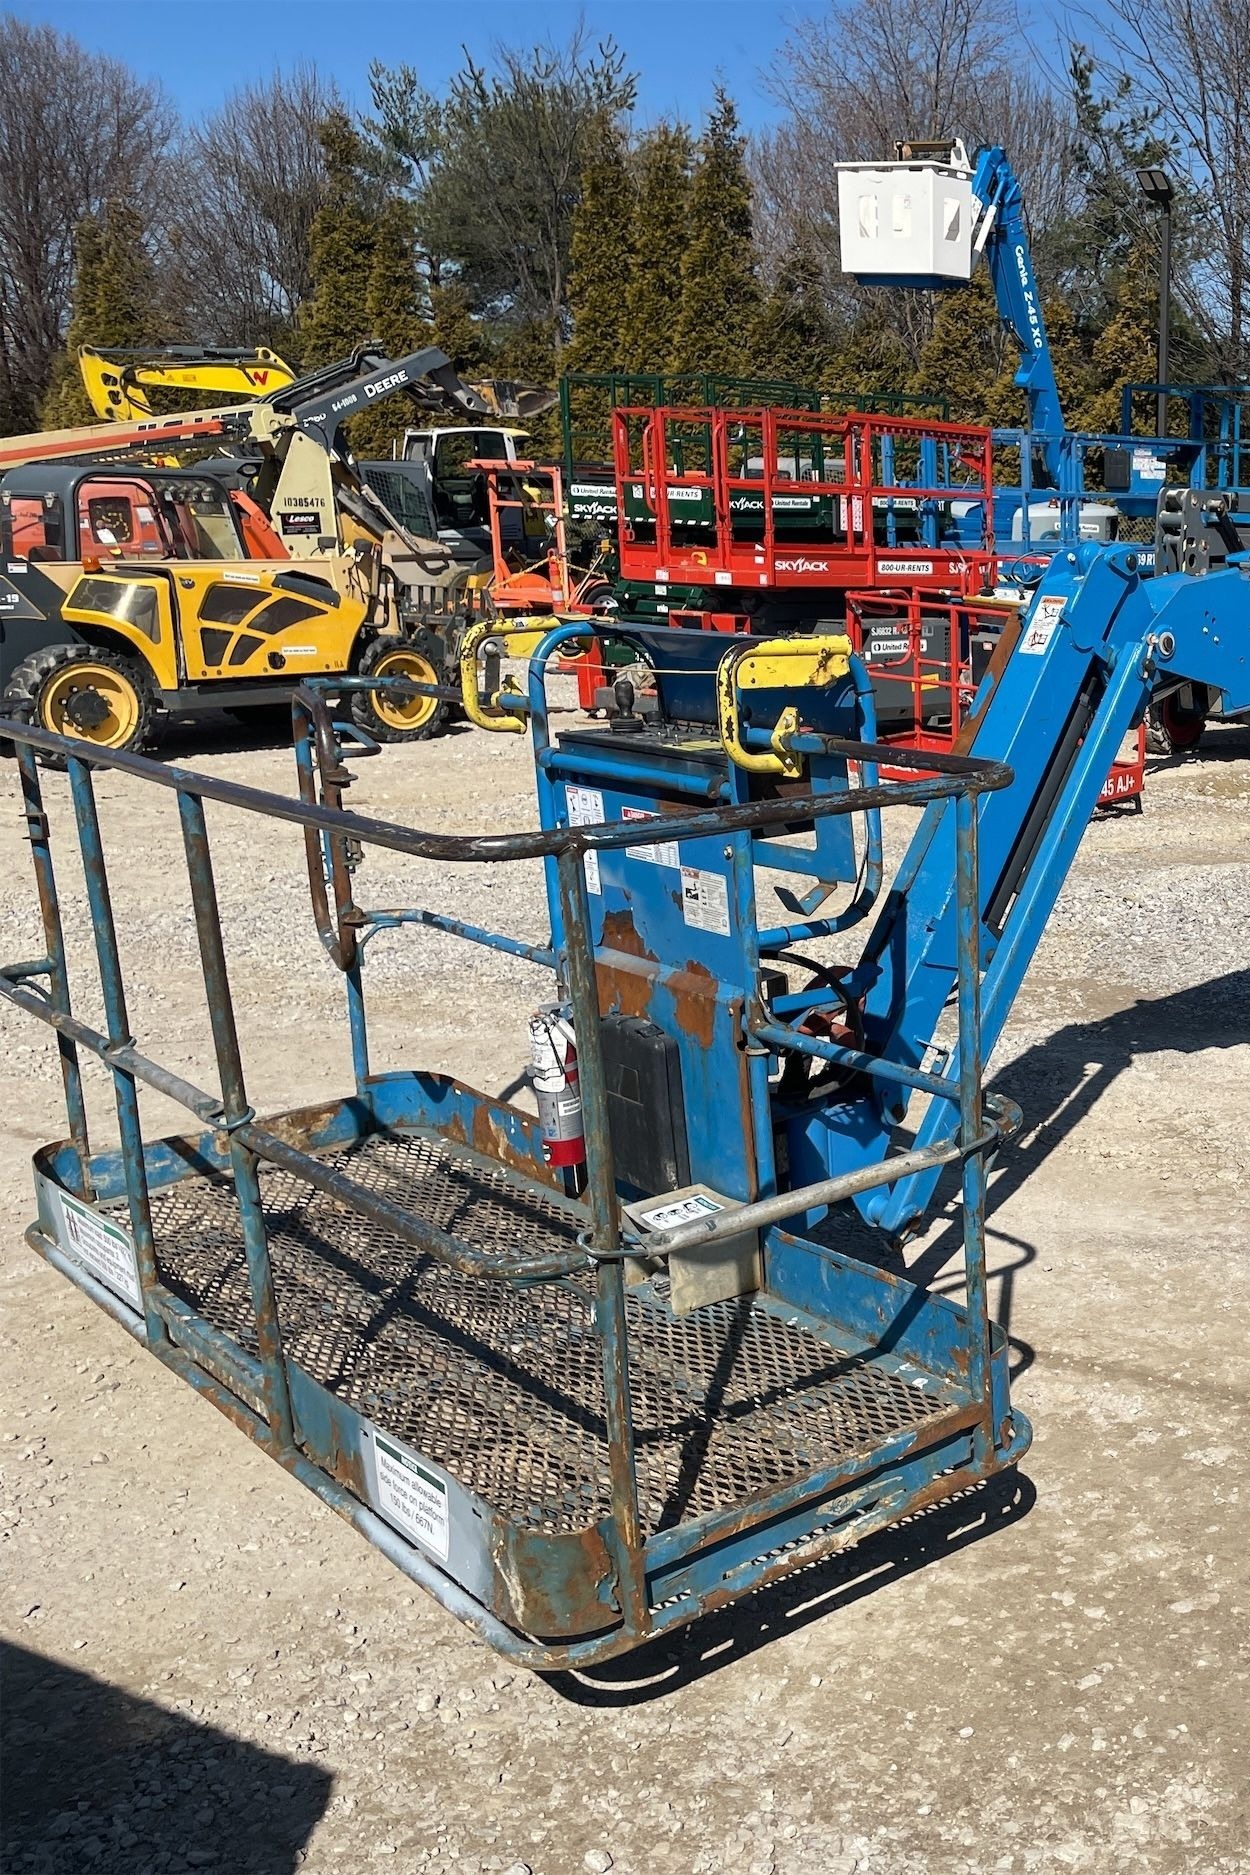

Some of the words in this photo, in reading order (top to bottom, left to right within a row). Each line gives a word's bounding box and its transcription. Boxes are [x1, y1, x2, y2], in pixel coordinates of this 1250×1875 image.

[1015, 245, 1029, 287] Genie
[1024, 291, 1038, 325] Z-45
[1031, 327, 1042, 348] XC
[363, 370, 409, 398] DEERE
[284, 497, 326, 507] 10385476
[574, 501, 617, 514] SKYJACK
[730, 497, 764, 510] KYJACK
[289, 514, 315, 523] Lesco
[775, 557, 829, 573] SKYJACK
[881, 564, 930, 573] 800-UR-RENTS
[882, 642, 902, 651] United
[381, 1456, 411, 1486] Maximum
[412, 1480, 442, 1508] allowable
